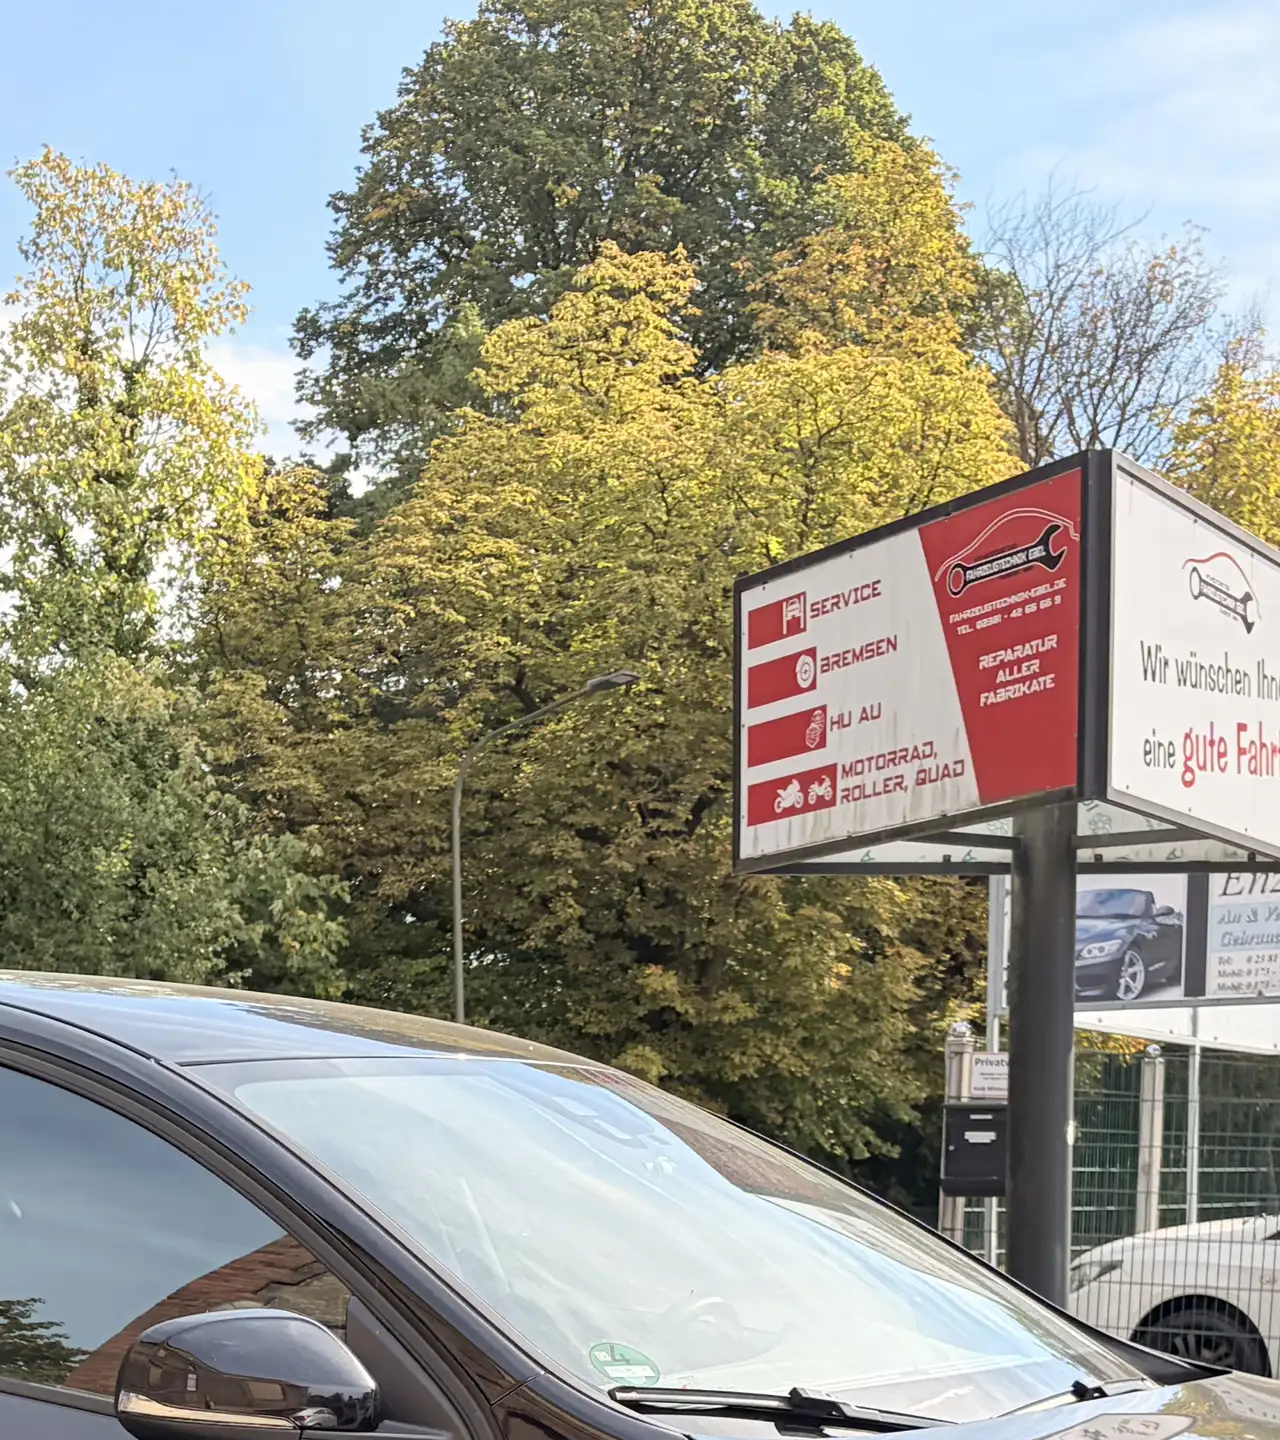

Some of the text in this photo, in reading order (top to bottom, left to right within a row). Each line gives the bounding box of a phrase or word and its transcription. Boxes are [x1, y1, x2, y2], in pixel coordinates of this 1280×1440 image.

[810, 580, 882, 619] SERVICE
[1010, 608, 1023, 618] 42
[1025, 603, 1037, 614] 66
[1039, 598, 1052, 609] 66
[1054, 595, 1061, 604] 9
[820, 634, 898, 674] BREMSEN
[979, 634, 1057, 670] REPARATUR
[1140, 640, 1169, 685] Wir
[1175, 651, 1251, 698] wünschen
[995, 659, 1039, 683] ALLER
[980, 674, 1055, 707] FABRIKATE
[830, 702, 882, 732] HU AU
[841, 741, 937, 780] MOTORRAD,
[1143, 728, 1176, 769] eine
[1181, 721, 1228, 788] gute
[840, 759, 965, 805] ROLLER, QUAD
[1218, 908, 1242, 925] An
[1245, 908, 1258, 924] &
[609, 1344, 630, 1365] 4
